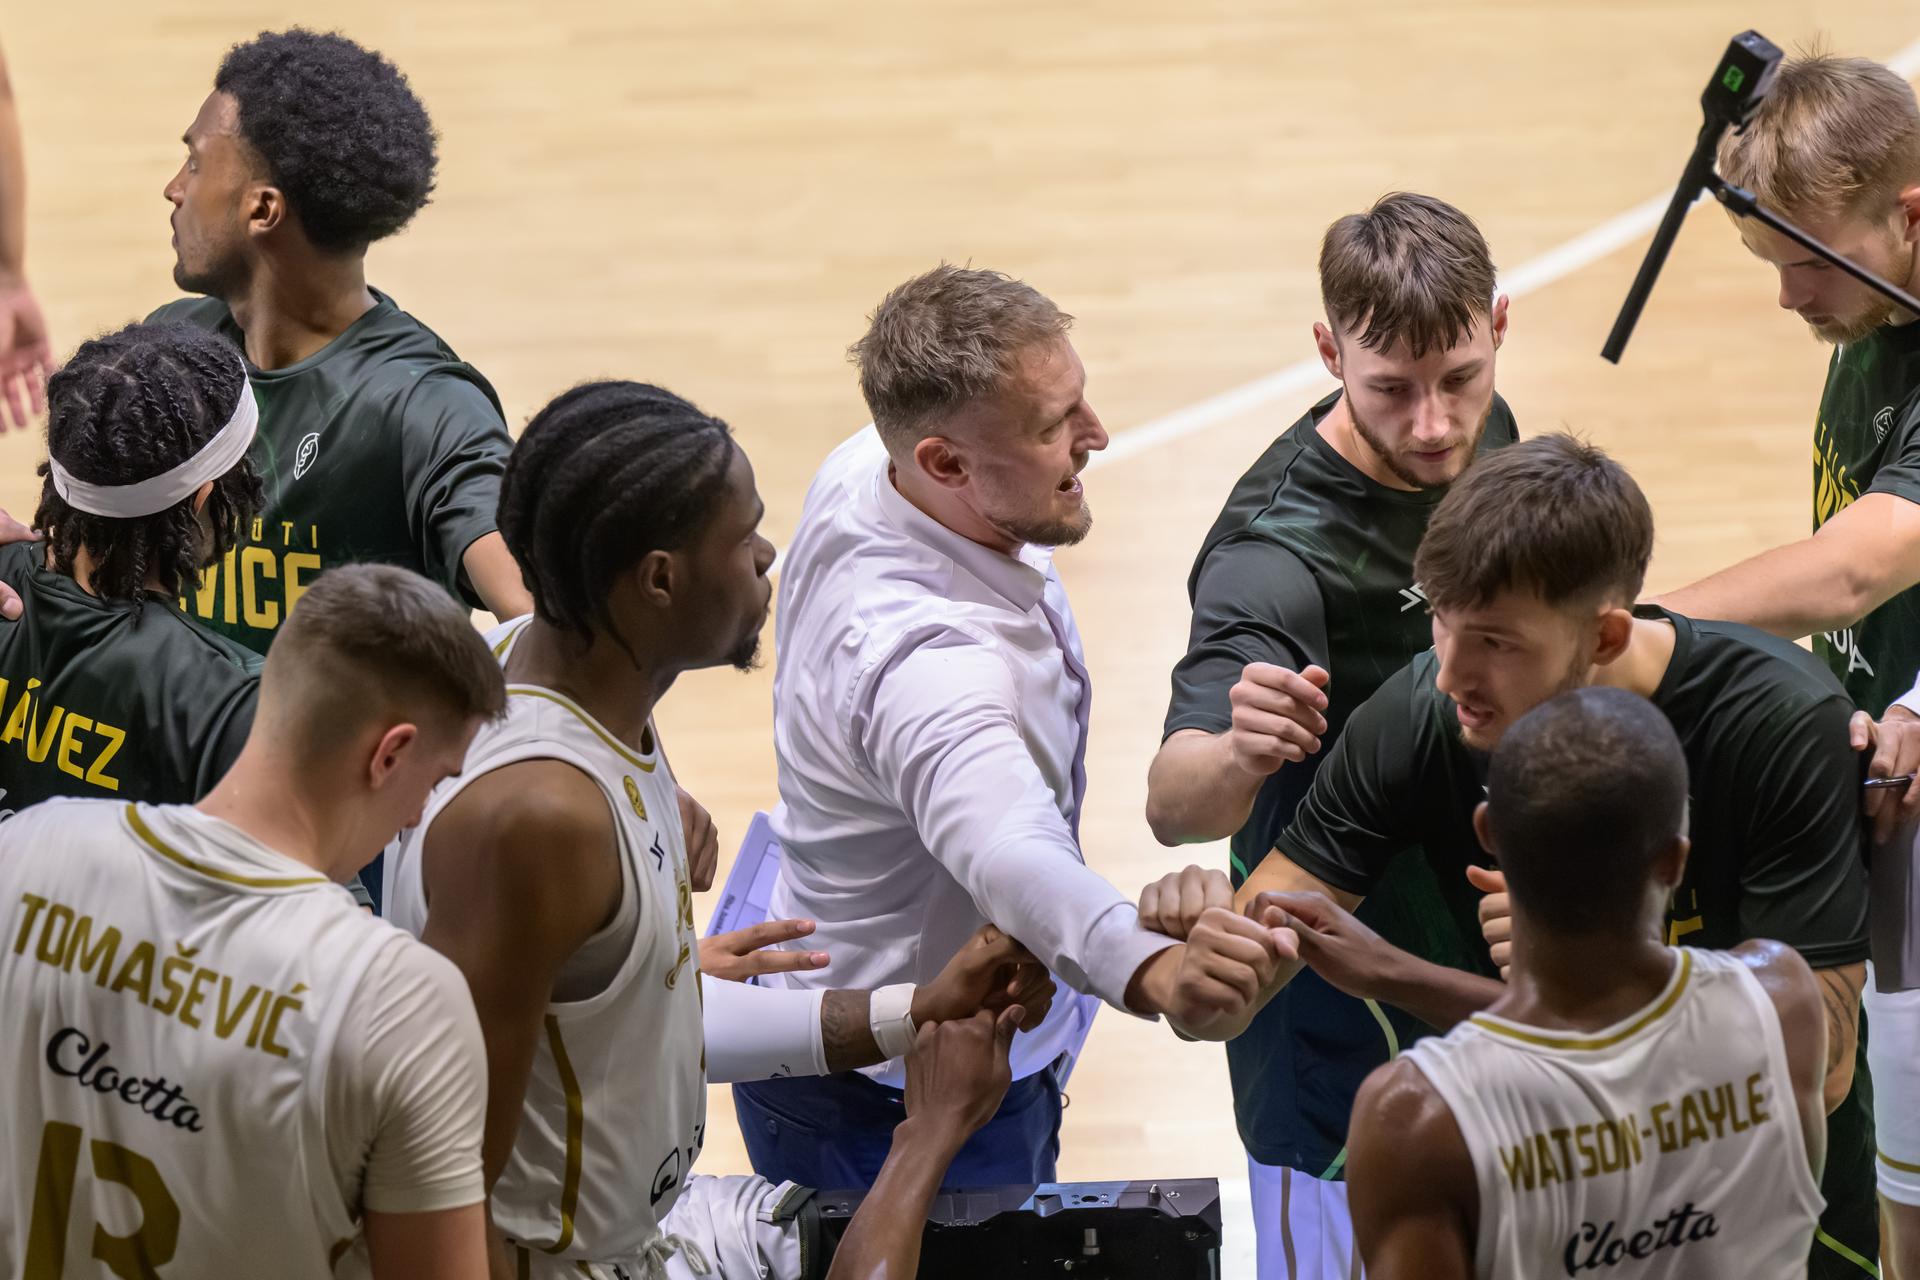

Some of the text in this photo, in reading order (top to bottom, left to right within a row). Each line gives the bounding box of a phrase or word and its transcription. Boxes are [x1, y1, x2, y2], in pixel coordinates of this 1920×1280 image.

[179, 543, 321, 630] VICE
[13, 892, 310, 1059] TOMAŠEVIĆ
[46, 1027, 204, 1133] Cloetta
[1498, 1072, 1771, 1193] WATSON-GAYLE
[1563, 1201, 1720, 1278] Cloetta
